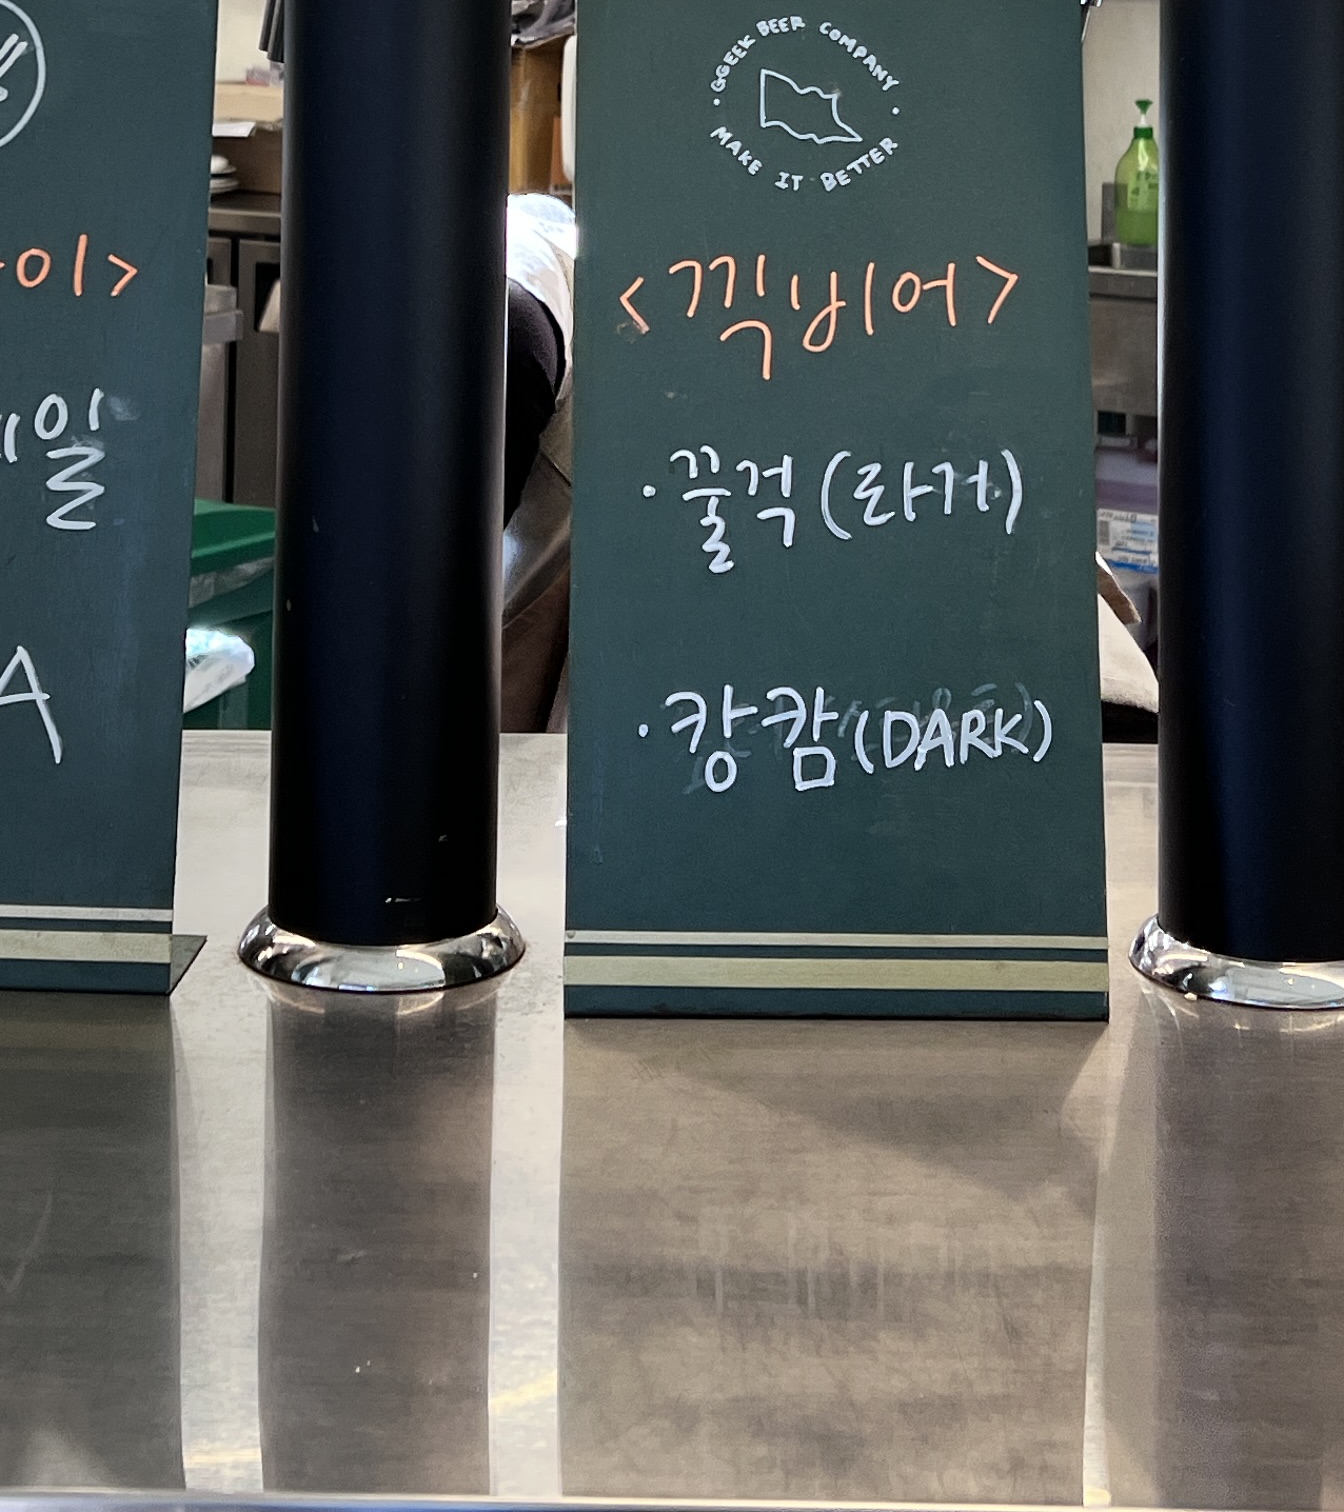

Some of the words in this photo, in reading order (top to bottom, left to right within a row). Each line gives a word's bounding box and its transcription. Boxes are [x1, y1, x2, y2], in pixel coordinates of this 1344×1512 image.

[756, 16, 805, 37] BEER
[819, 21, 899, 91] COMPANY
[710, 126, 762, 175] MAKE
[775, 171, 803, 191] IT
[820, 137, 898, 191] BETTER
